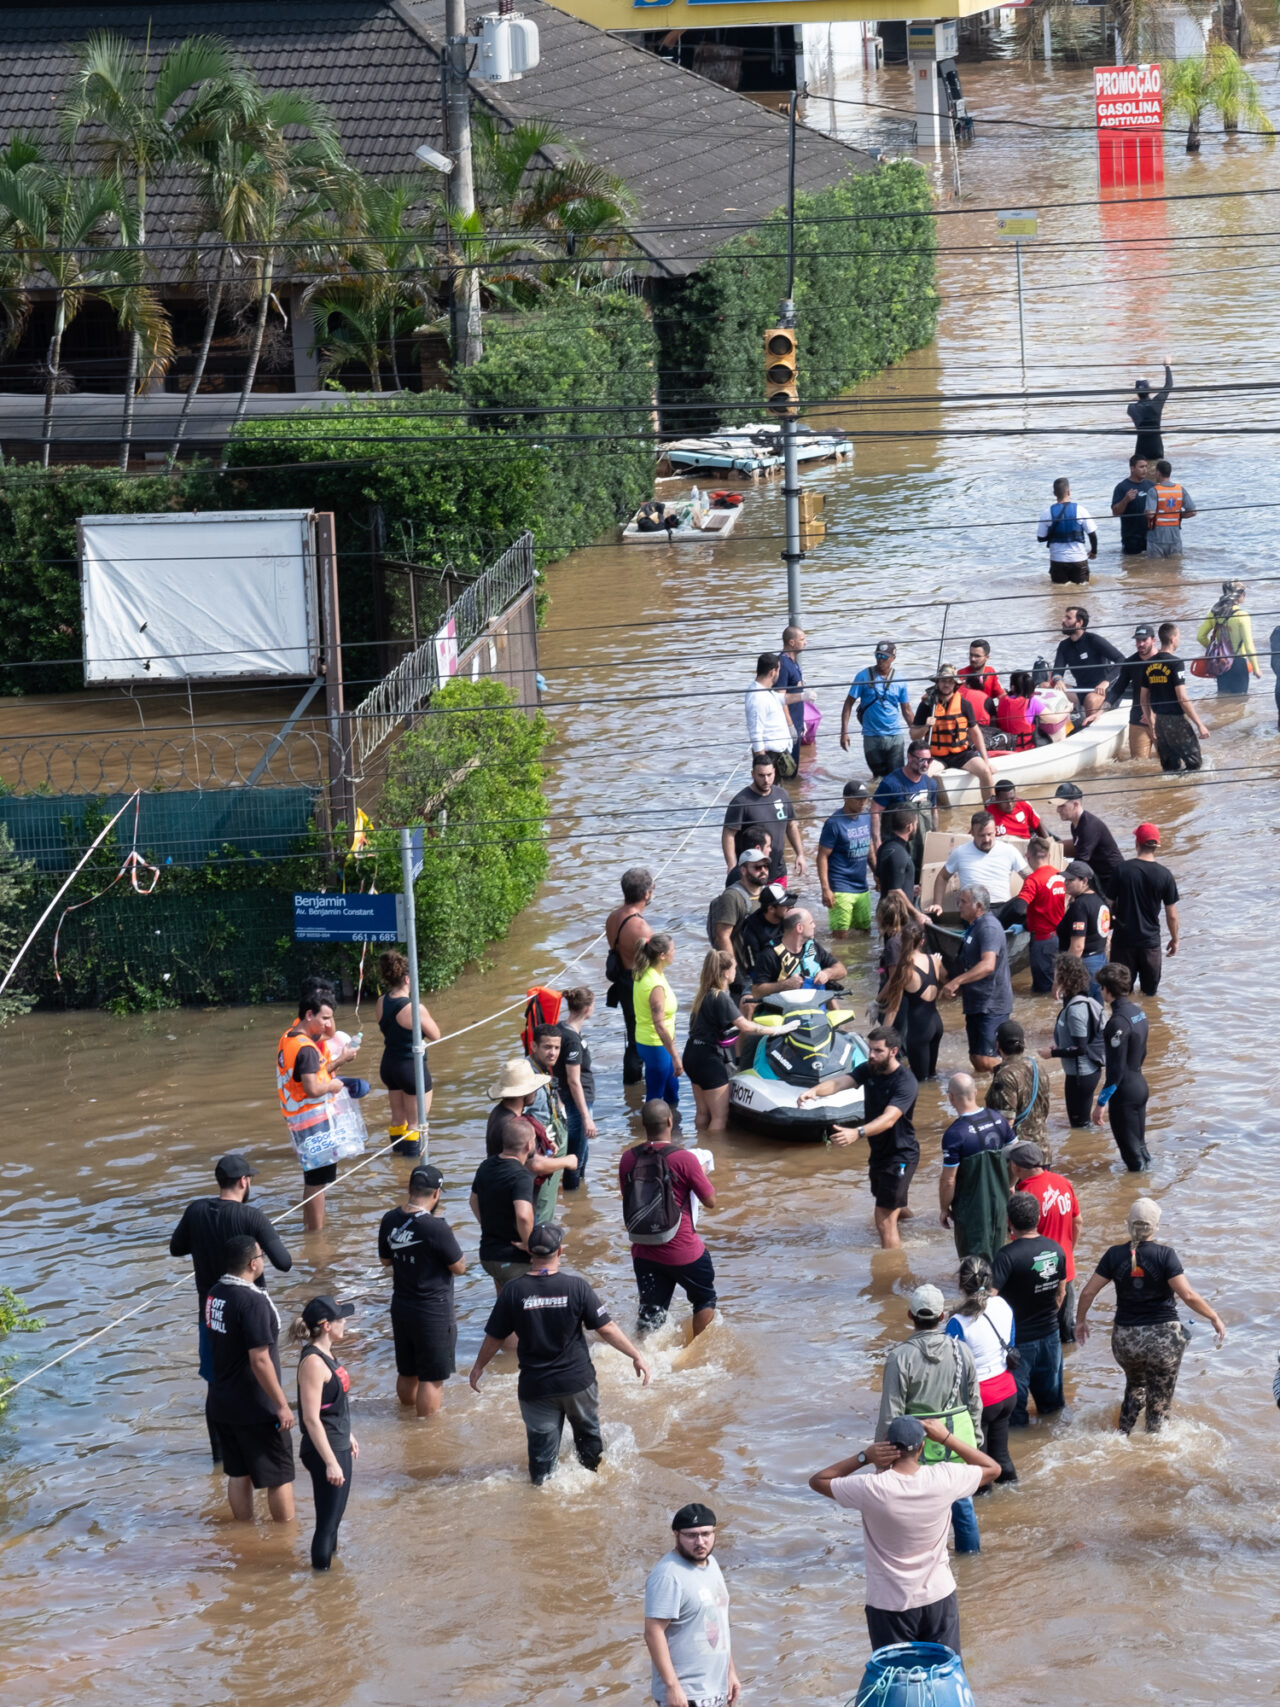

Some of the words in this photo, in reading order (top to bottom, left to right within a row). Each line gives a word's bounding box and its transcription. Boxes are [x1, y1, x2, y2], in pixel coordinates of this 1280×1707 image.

[1096, 70, 1160, 99] PROMOÇÃO
[1098, 101, 1160, 116] GASOLINA
[1100, 115, 1160, 127] ADITIVADA
[294, 895, 346, 908] Benjamin
[308, 908, 341, 917] Benjamin
[343, 908, 374, 916] Constant
[352, 933, 367, 941] 661
[379, 933, 396, 941] 685
[212, 1298, 226, 1310] OFF
[211, 1308, 223, 1321] THE
[211, 1319, 227, 1334] WALL
